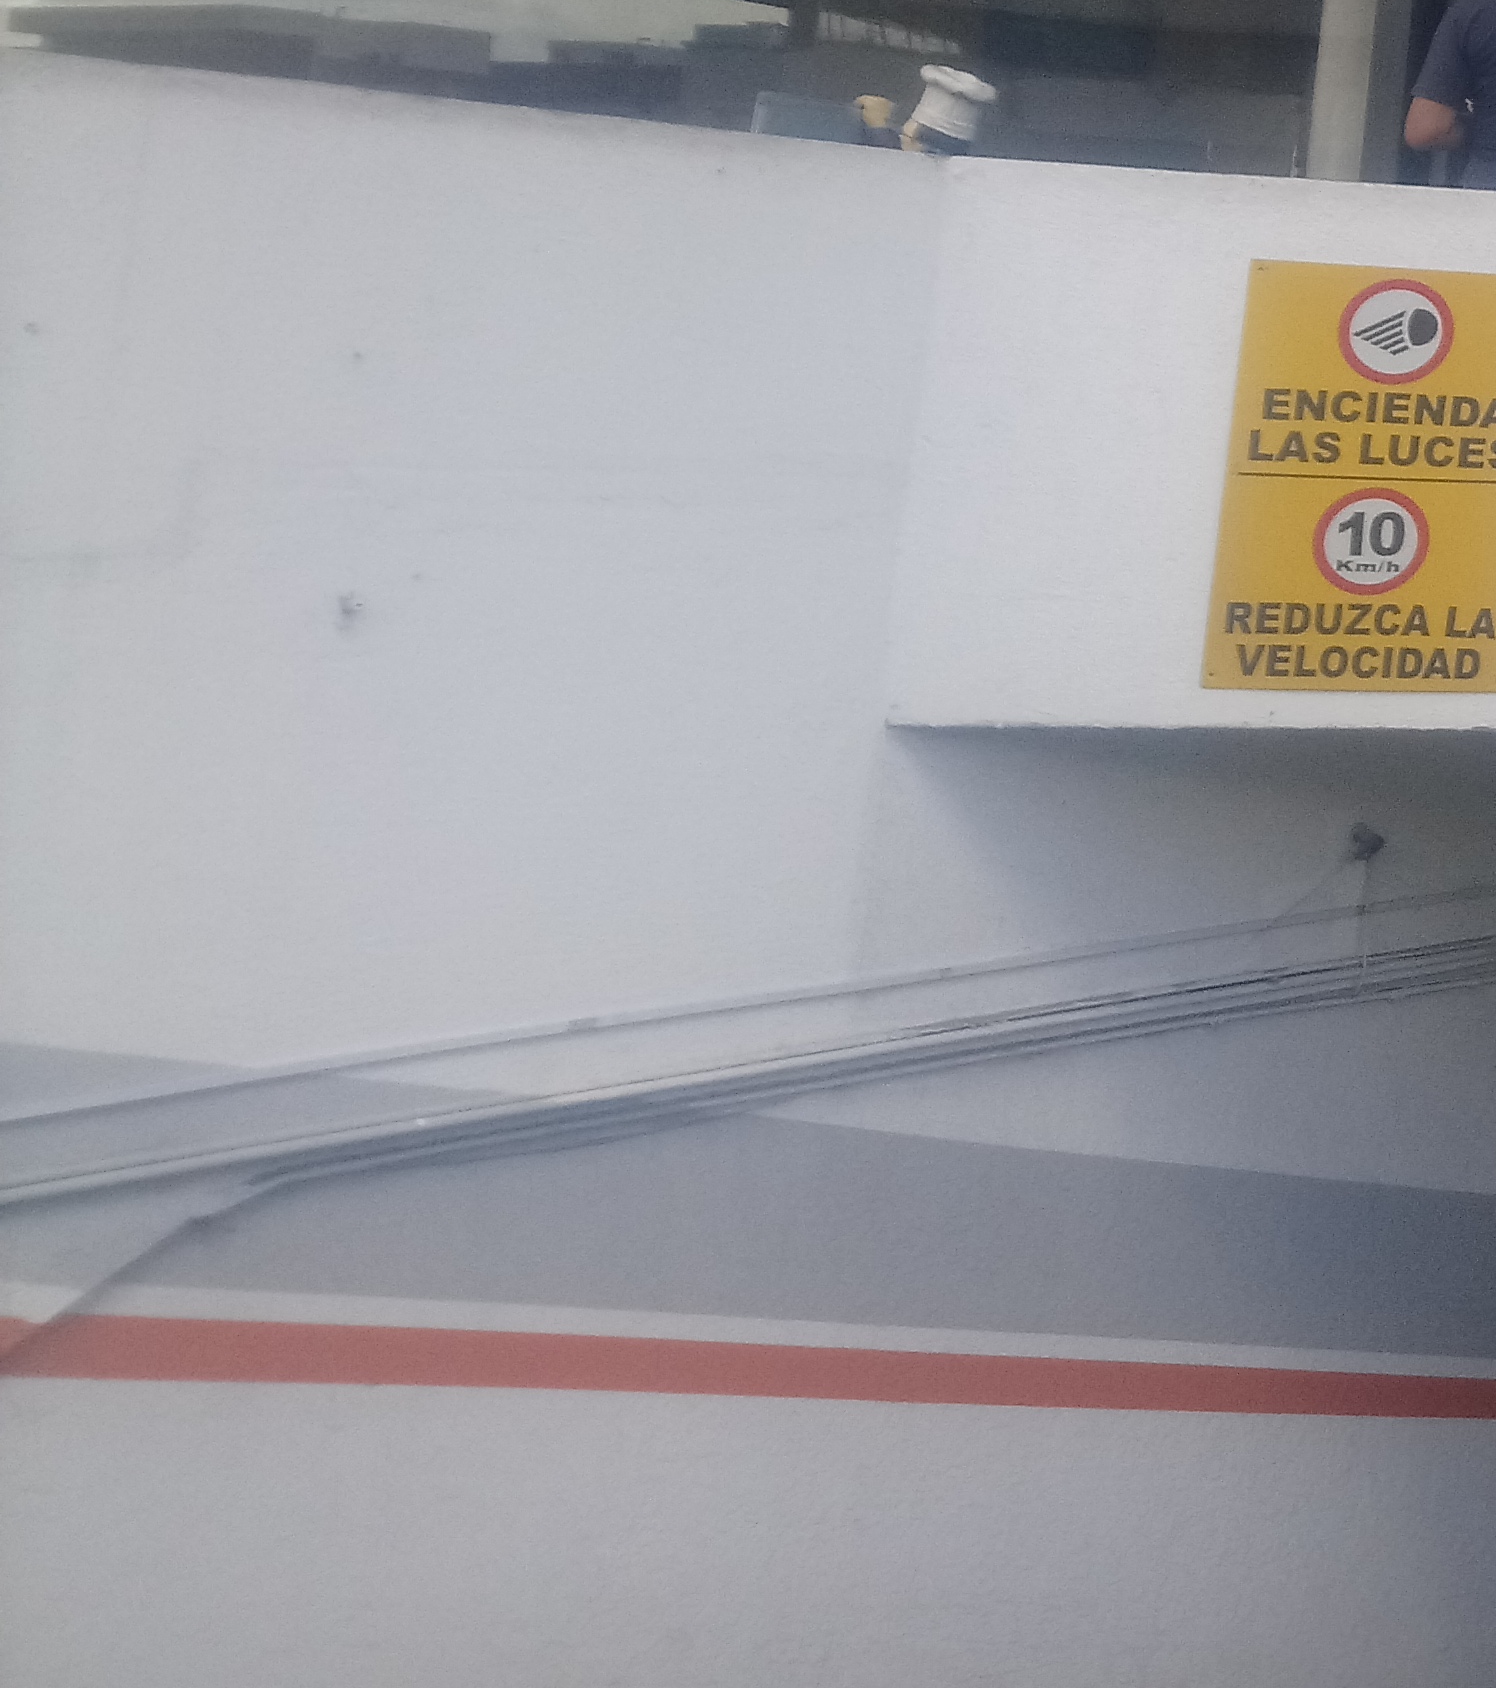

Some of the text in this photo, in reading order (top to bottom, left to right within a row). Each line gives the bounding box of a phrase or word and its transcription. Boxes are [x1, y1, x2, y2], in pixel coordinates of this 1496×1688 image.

[1248, 429, 1341, 463] LAS
[1337, 511, 1407, 557] 10
[1336, 560, 1400, 573] Km/h
[1225, 601, 1496, 639] REDUZCA LA
[1235, 644, 1481, 680] VELOCIDAD
